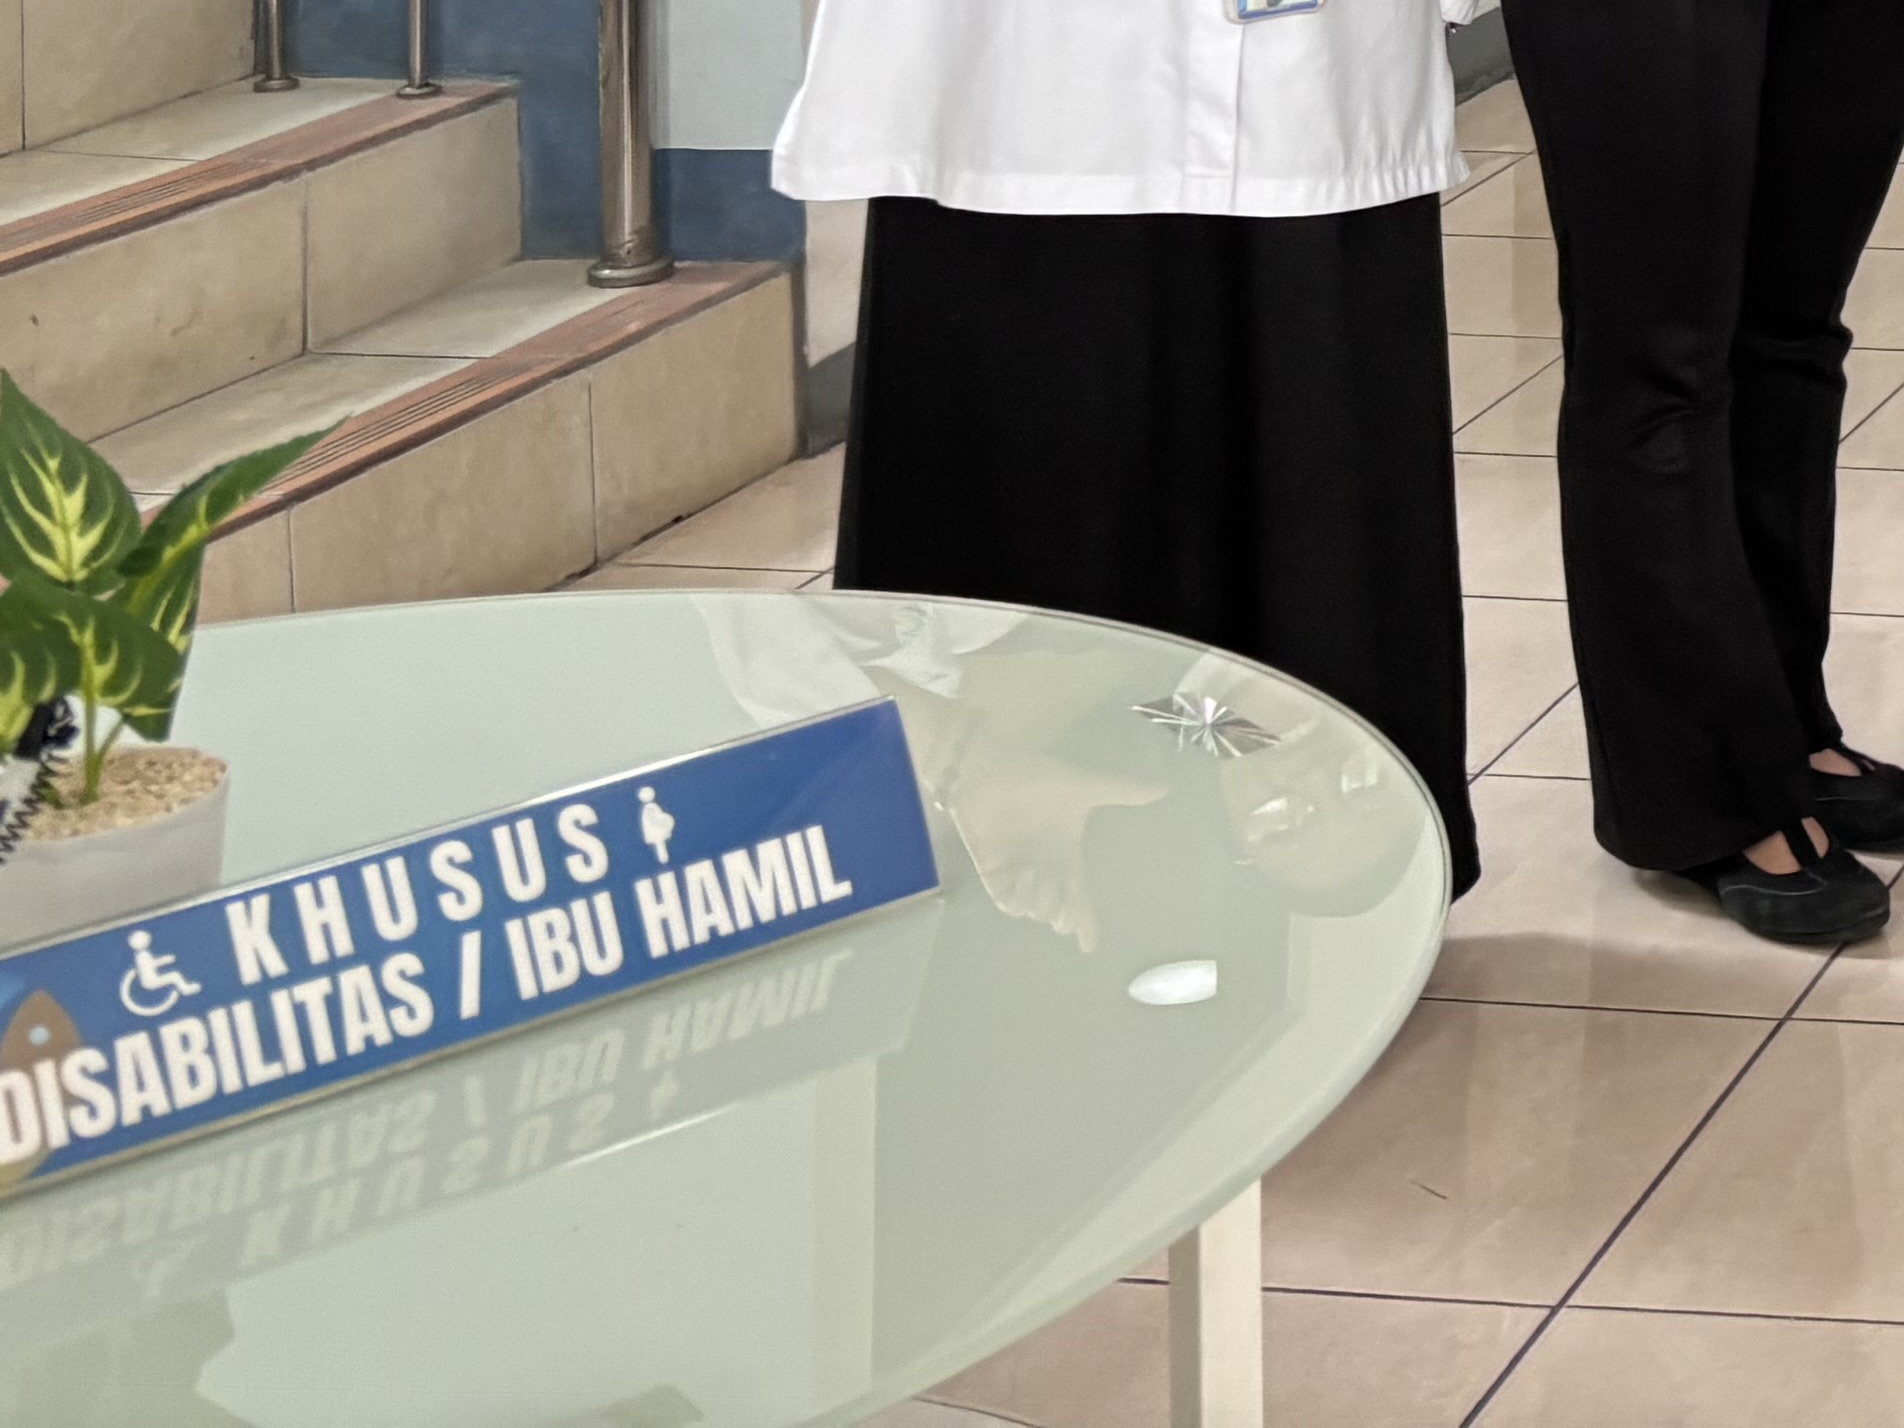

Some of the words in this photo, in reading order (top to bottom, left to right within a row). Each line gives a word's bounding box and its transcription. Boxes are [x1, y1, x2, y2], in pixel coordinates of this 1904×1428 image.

[0, 952, 435, 1170] DISABILITAS
[459, 930, 483, 1020] /
[505, 892, 625, 1001] IBU
[634, 824, 854, 960] HAMIL
[225, 802, 610, 987] KHUSUS
